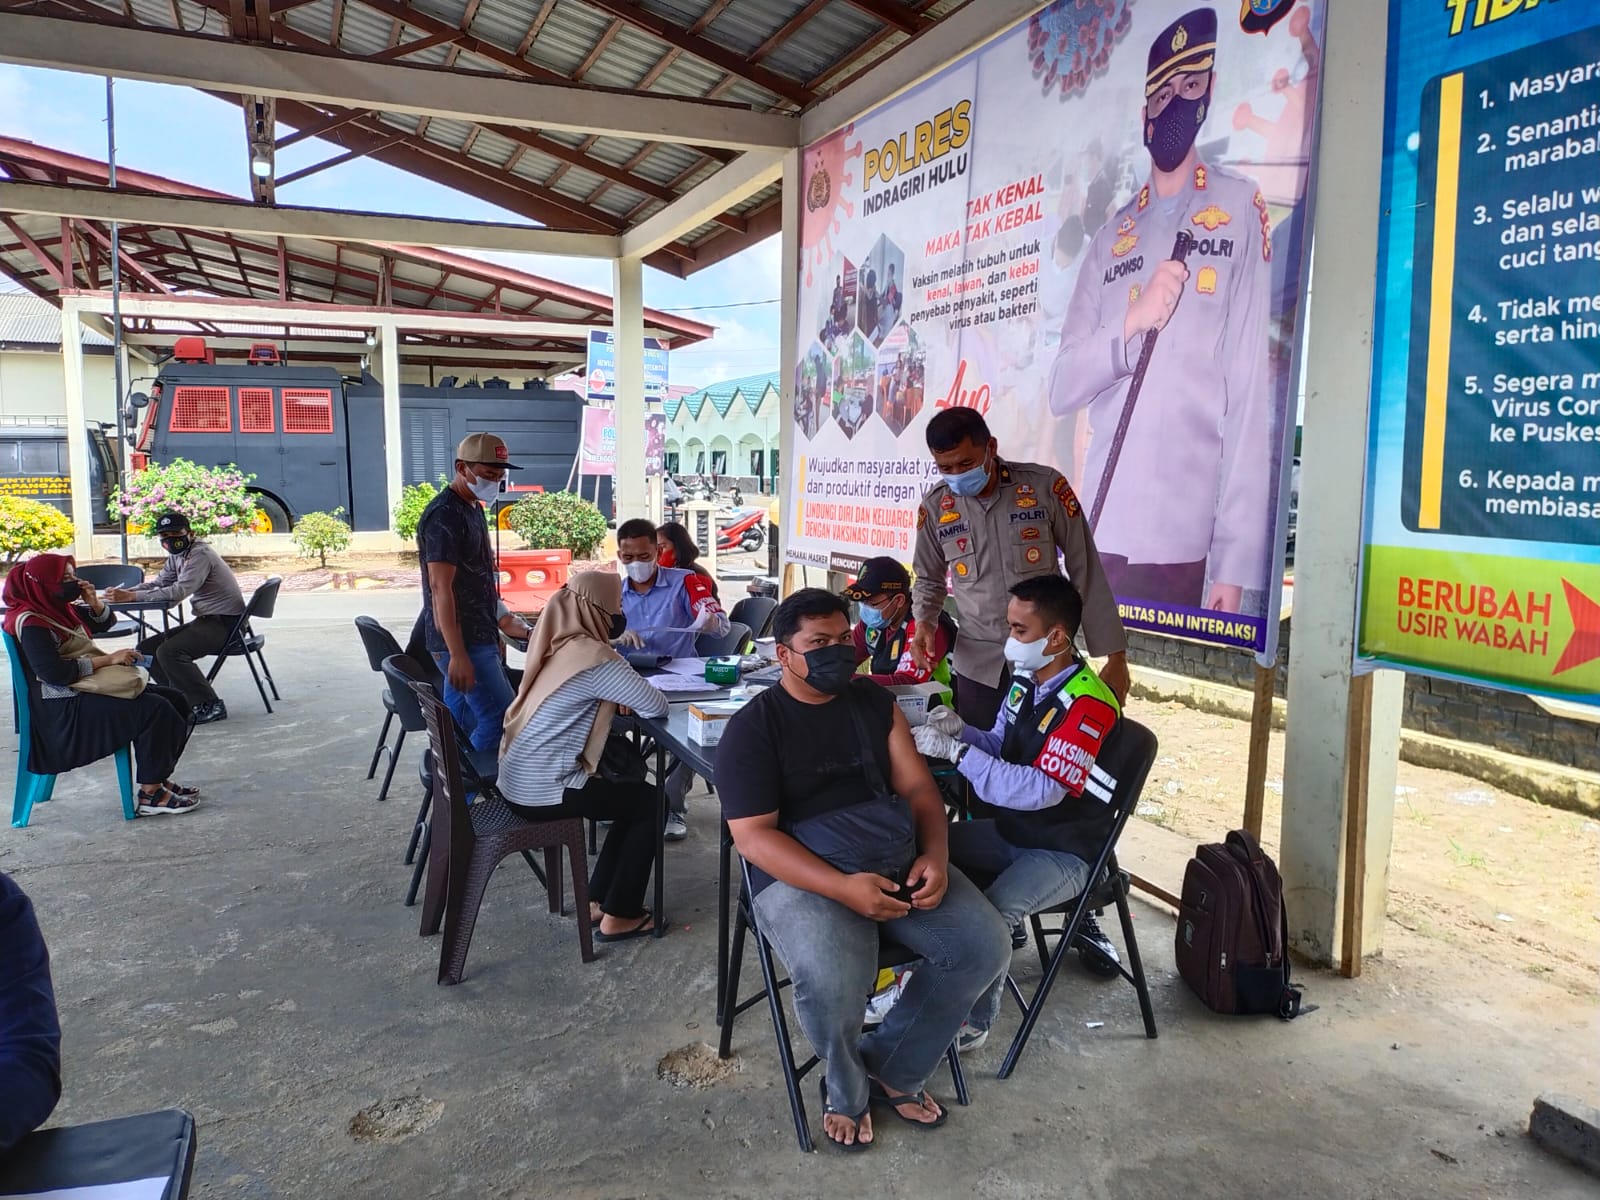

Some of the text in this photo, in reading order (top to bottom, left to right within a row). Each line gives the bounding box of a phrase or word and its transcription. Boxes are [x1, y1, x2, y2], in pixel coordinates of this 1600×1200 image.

[1479, 90, 1495, 109] 1.
[1476, 103, 1600, 153] 2. Senanti
[863, 99, 972, 192] POLRES
[863, 153, 968, 217] INDRAGIRI HULU
[966, 174, 1045, 220] TAK KENAL
[1473, 206, 1492, 224] 3.
[1502, 189, 1573, 219] Selalu
[925, 201, 1044, 257] MAKA TAK KEBAL
[1500, 211, 1600, 245] dan sela
[1188, 238, 1234, 257] POLRI
[1499, 243, 1546, 270] cuci
[912, 239, 1040, 289] Vaksin melatih tubuh untuk
[954, 277, 984, 296] lawan,
[987, 271, 1007, 286] dan
[1009, 258, 1040, 280] kebal
[1103, 255, 1144, 285] ALPONSO
[910, 277, 1038, 325] penyebab penyakit, seperti
[949, 297, 1037, 330] virus atau bakteri
[1468, 305, 1488, 323] 4.
[1497, 296, 1561, 320] Tidak
[1495, 318, 1600, 346] serta hin
[1464, 376, 1483, 394] 5.
[1493, 373, 1573, 396] Segera
[1492, 396, 1600, 418] Virus Cor
[1490, 423, 1516, 442] ke
[808, 457, 938, 479] Wujudkan masyarakat ya
[1459, 469, 1478, 488] 6.
[1487, 469, 1575, 493] Kepada
[807, 479, 823, 494] dan
[826, 480, 871, 498] produktif
[873, 483, 915, 502] dengan
[805, 502, 914, 529] LINDUNGI DIRI DAN KELUARGA
[1010, 510, 1045, 522] POLRI
[1485, 495, 1600, 518] membiasa
[805, 521, 908, 551] DENGAN VAKSINASI COVID-19
[939, 524, 968, 539] AMRIL
[808, 552, 828, 565] MASKER
[831, 556, 857, 570] MENCUCI
[1397, 576, 1552, 627] BERUBAH
[1118, 604, 1257, 641] BILTAS DAN INTERAKSI
[1397, 610, 1549, 656] USIR WABAH
